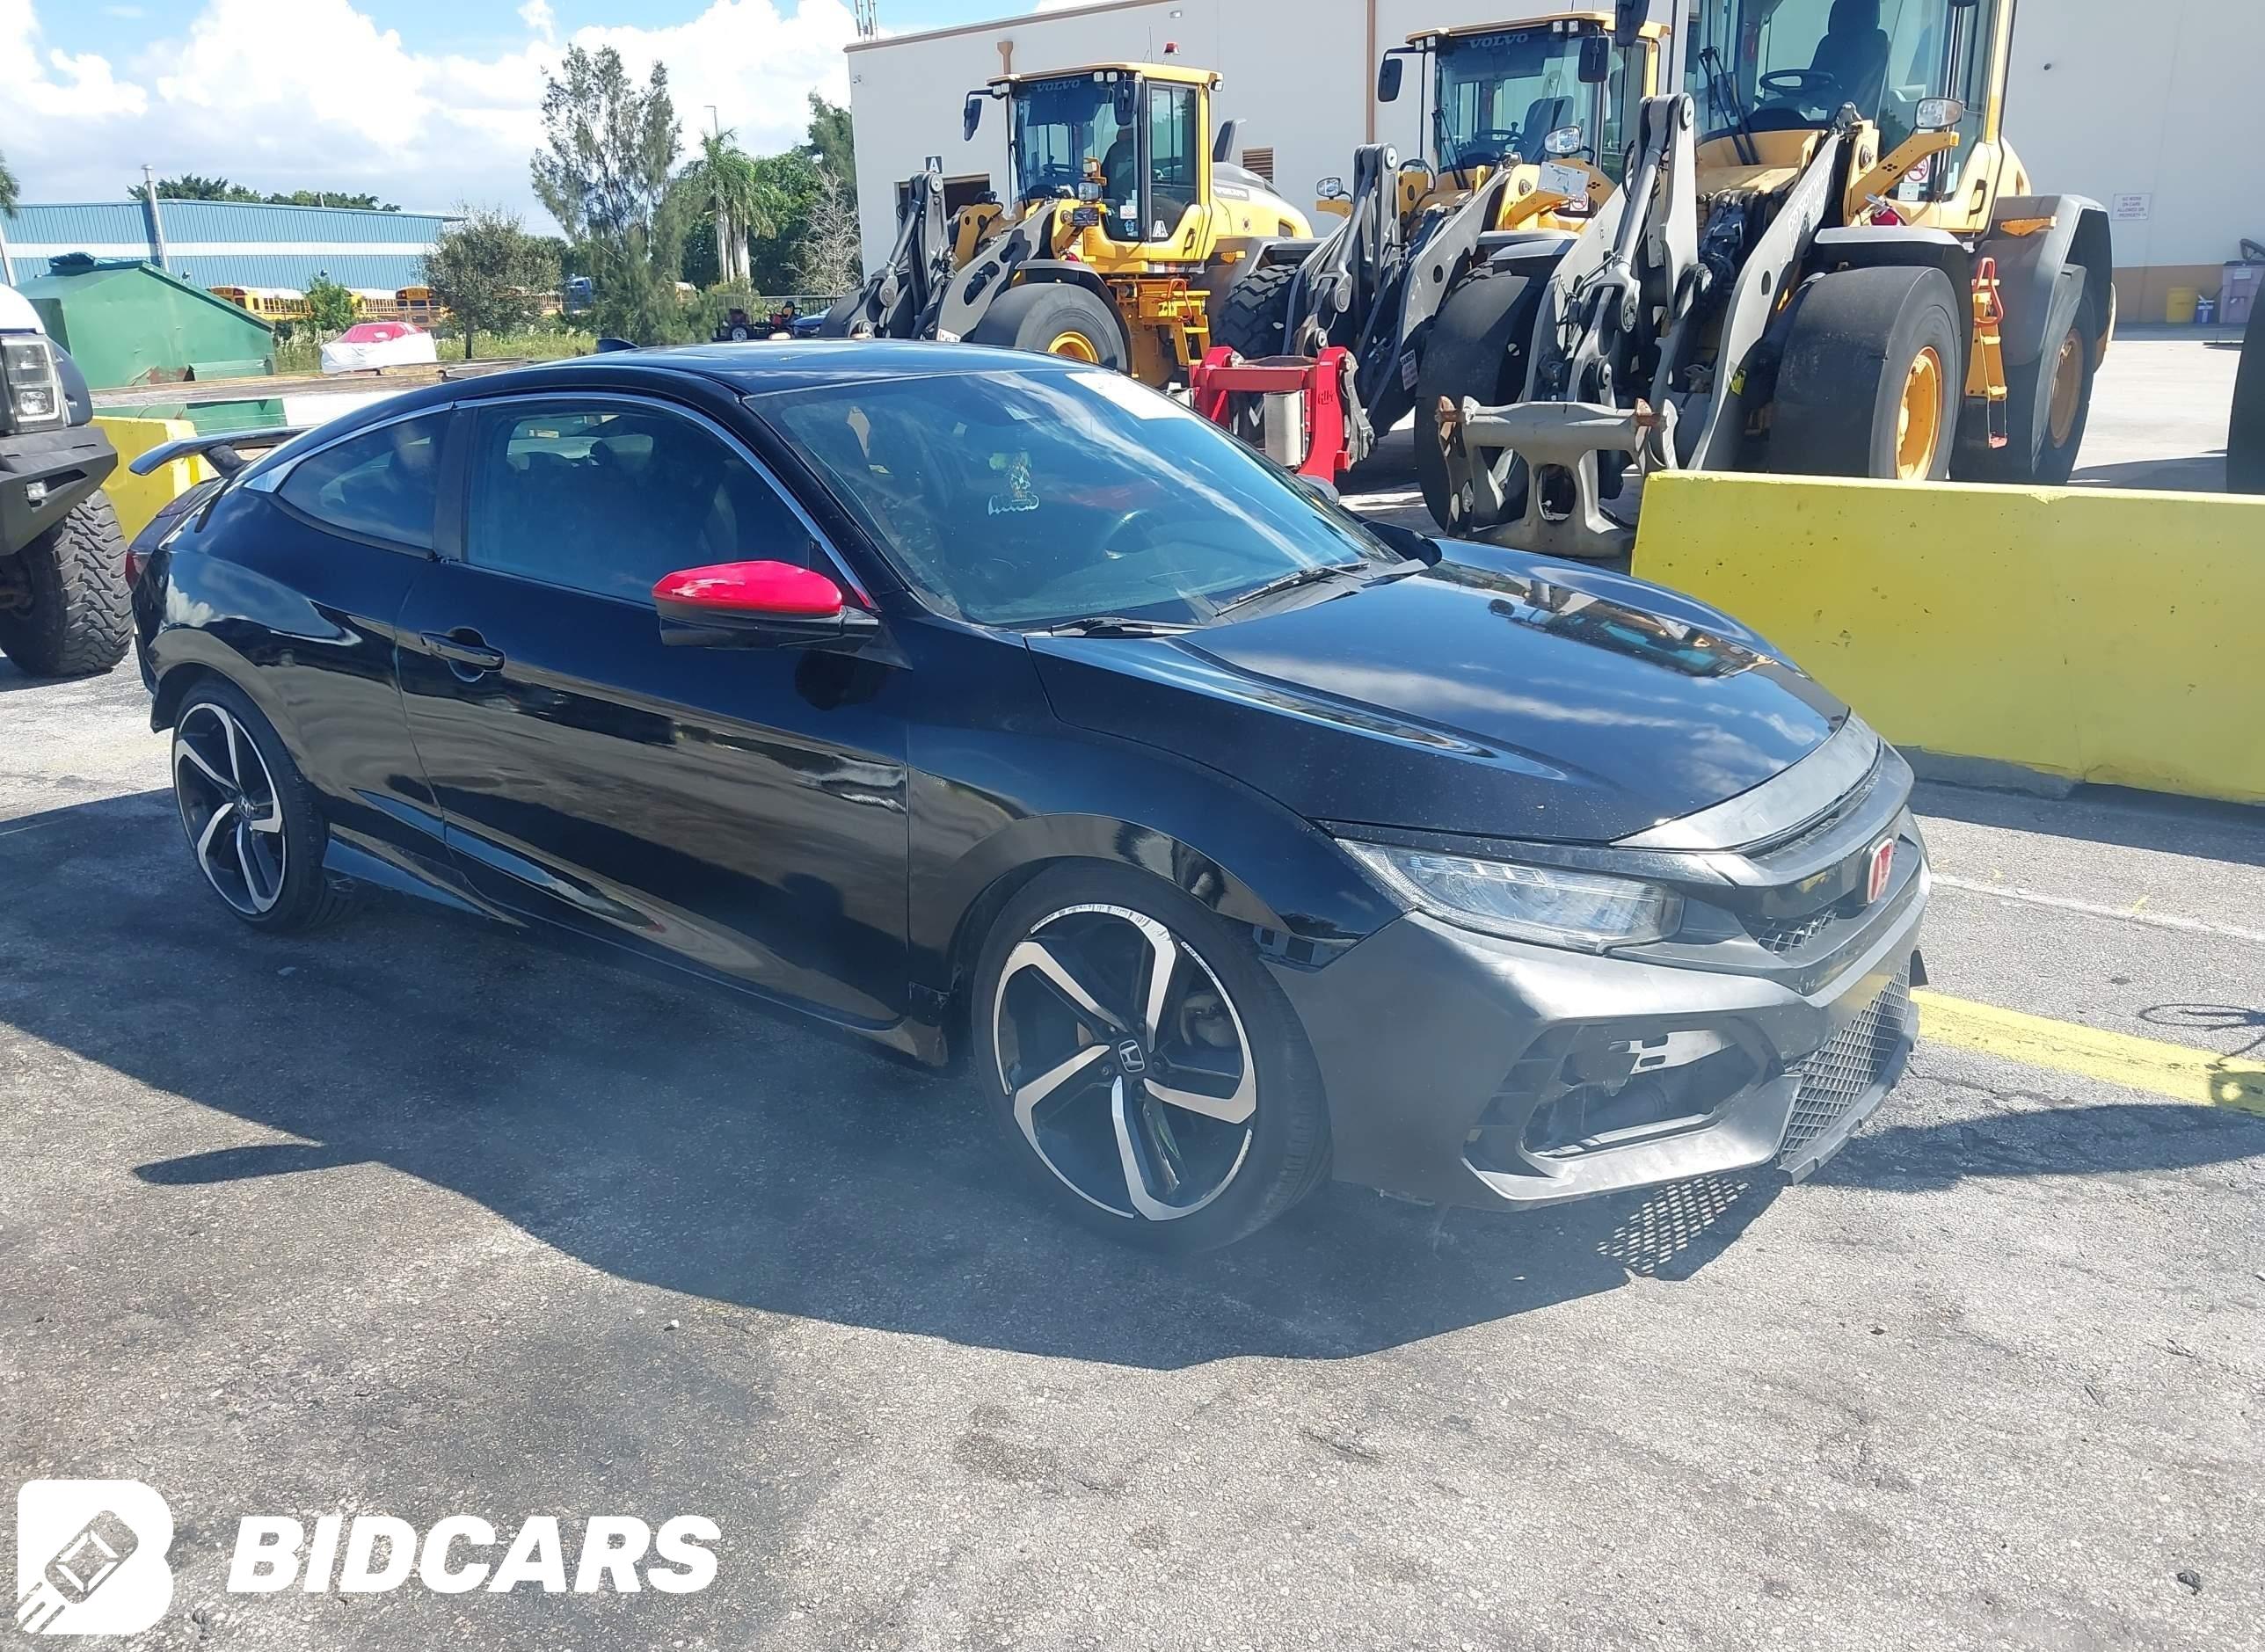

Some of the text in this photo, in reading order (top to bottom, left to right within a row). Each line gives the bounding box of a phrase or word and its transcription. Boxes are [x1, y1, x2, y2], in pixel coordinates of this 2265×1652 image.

[1469, 33, 1528, 48] VOLVO
[1037, 79, 1080, 91] VOLVO
[929, 157, 940, 172] A
